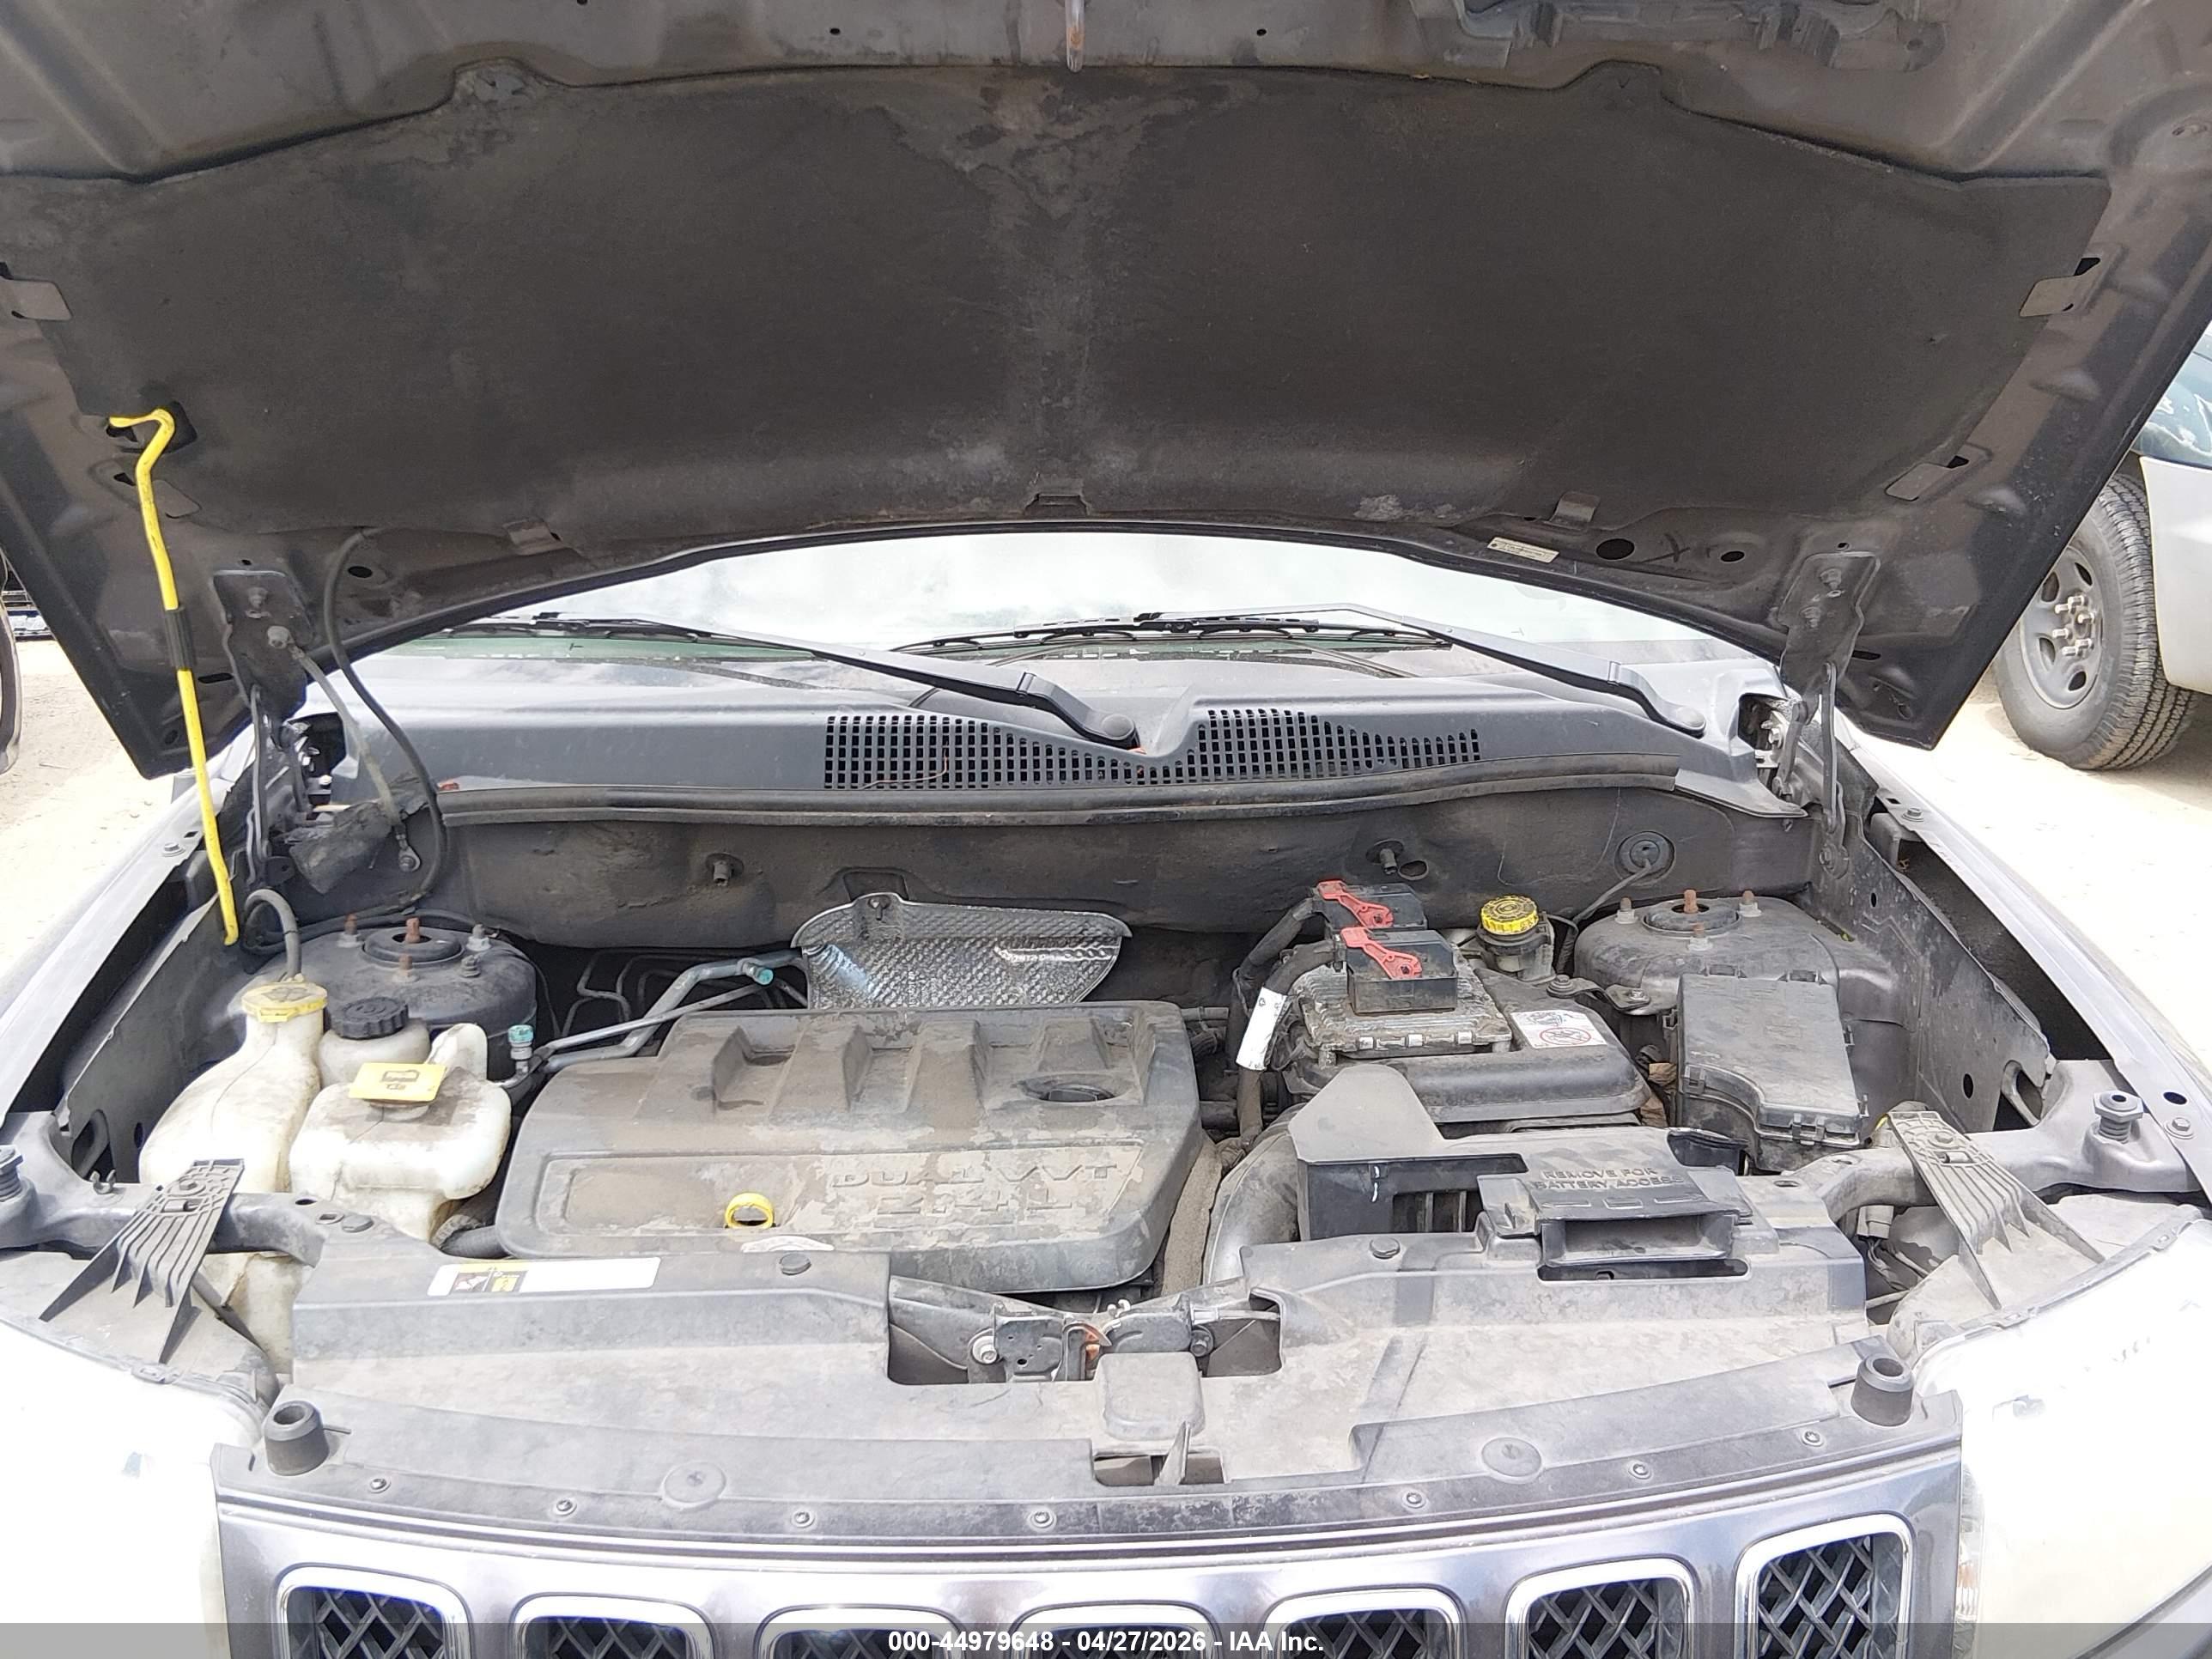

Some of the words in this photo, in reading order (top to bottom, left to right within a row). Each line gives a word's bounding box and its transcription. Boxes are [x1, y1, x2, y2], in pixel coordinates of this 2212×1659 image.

[830, 1165, 985, 1188] DUAL
[996, 1162, 1118, 1182] VVT
[1542, 1169, 1618, 1179] REMOVE
[1620, 1168, 1658, 1176] FOR
[1534, 1180, 1608, 1189] BATTERY
[1617, 1176, 1684, 1188] ACCESS
